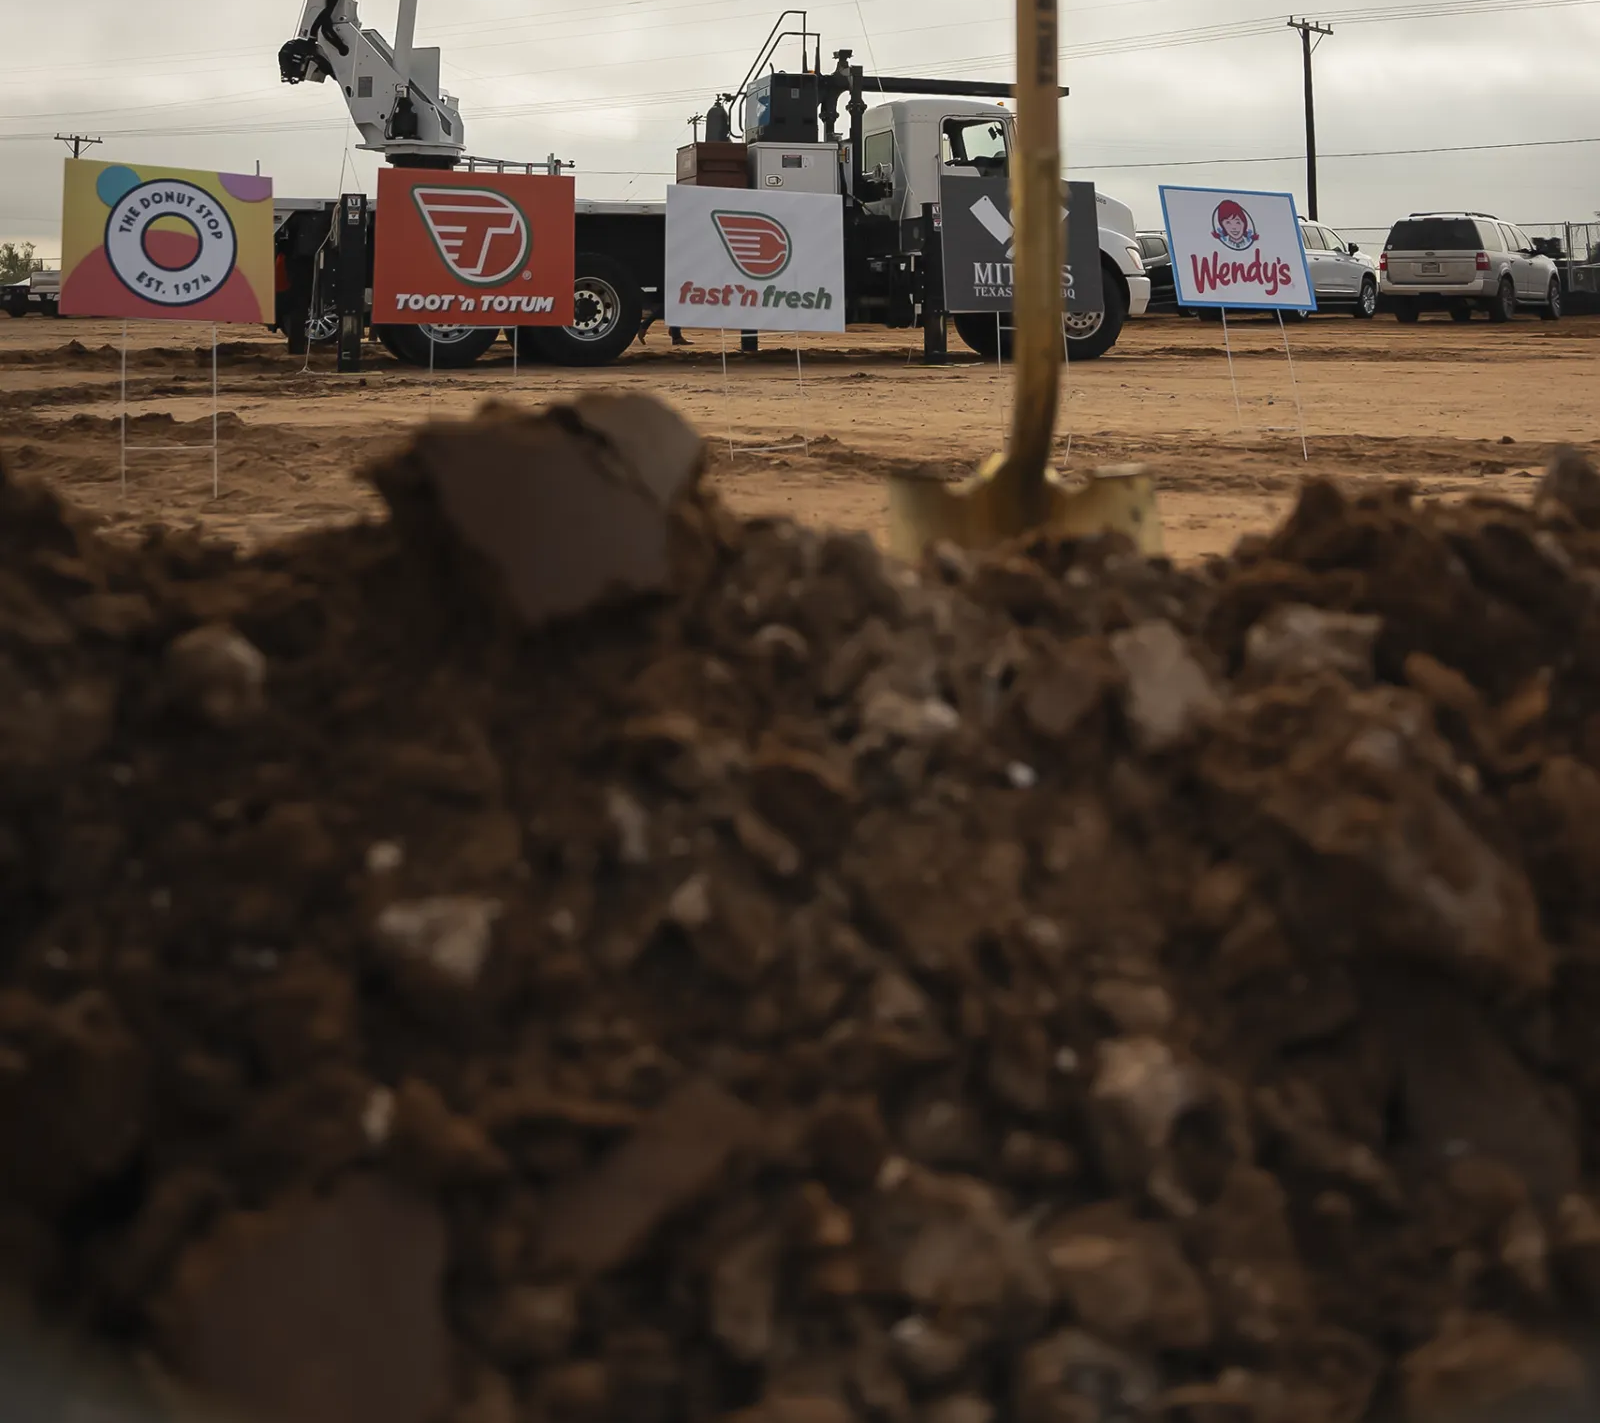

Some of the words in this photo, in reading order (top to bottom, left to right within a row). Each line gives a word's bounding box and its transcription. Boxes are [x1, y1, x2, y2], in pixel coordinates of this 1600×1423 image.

[119, 206, 141, 233] THE
[139, 191, 195, 209] DONUT
[195, 204, 223, 239] STOP
[136, 270, 166, 294] EST.
[174, 274, 212, 295] 1974
[1190, 248, 1292, 295] Wendy's
[395, 294, 455, 311] TOOT
[480, 295, 555, 313] TOTUM
[762, 285, 832, 310] fresh
[973, 286, 1013, 297] TEXAS
